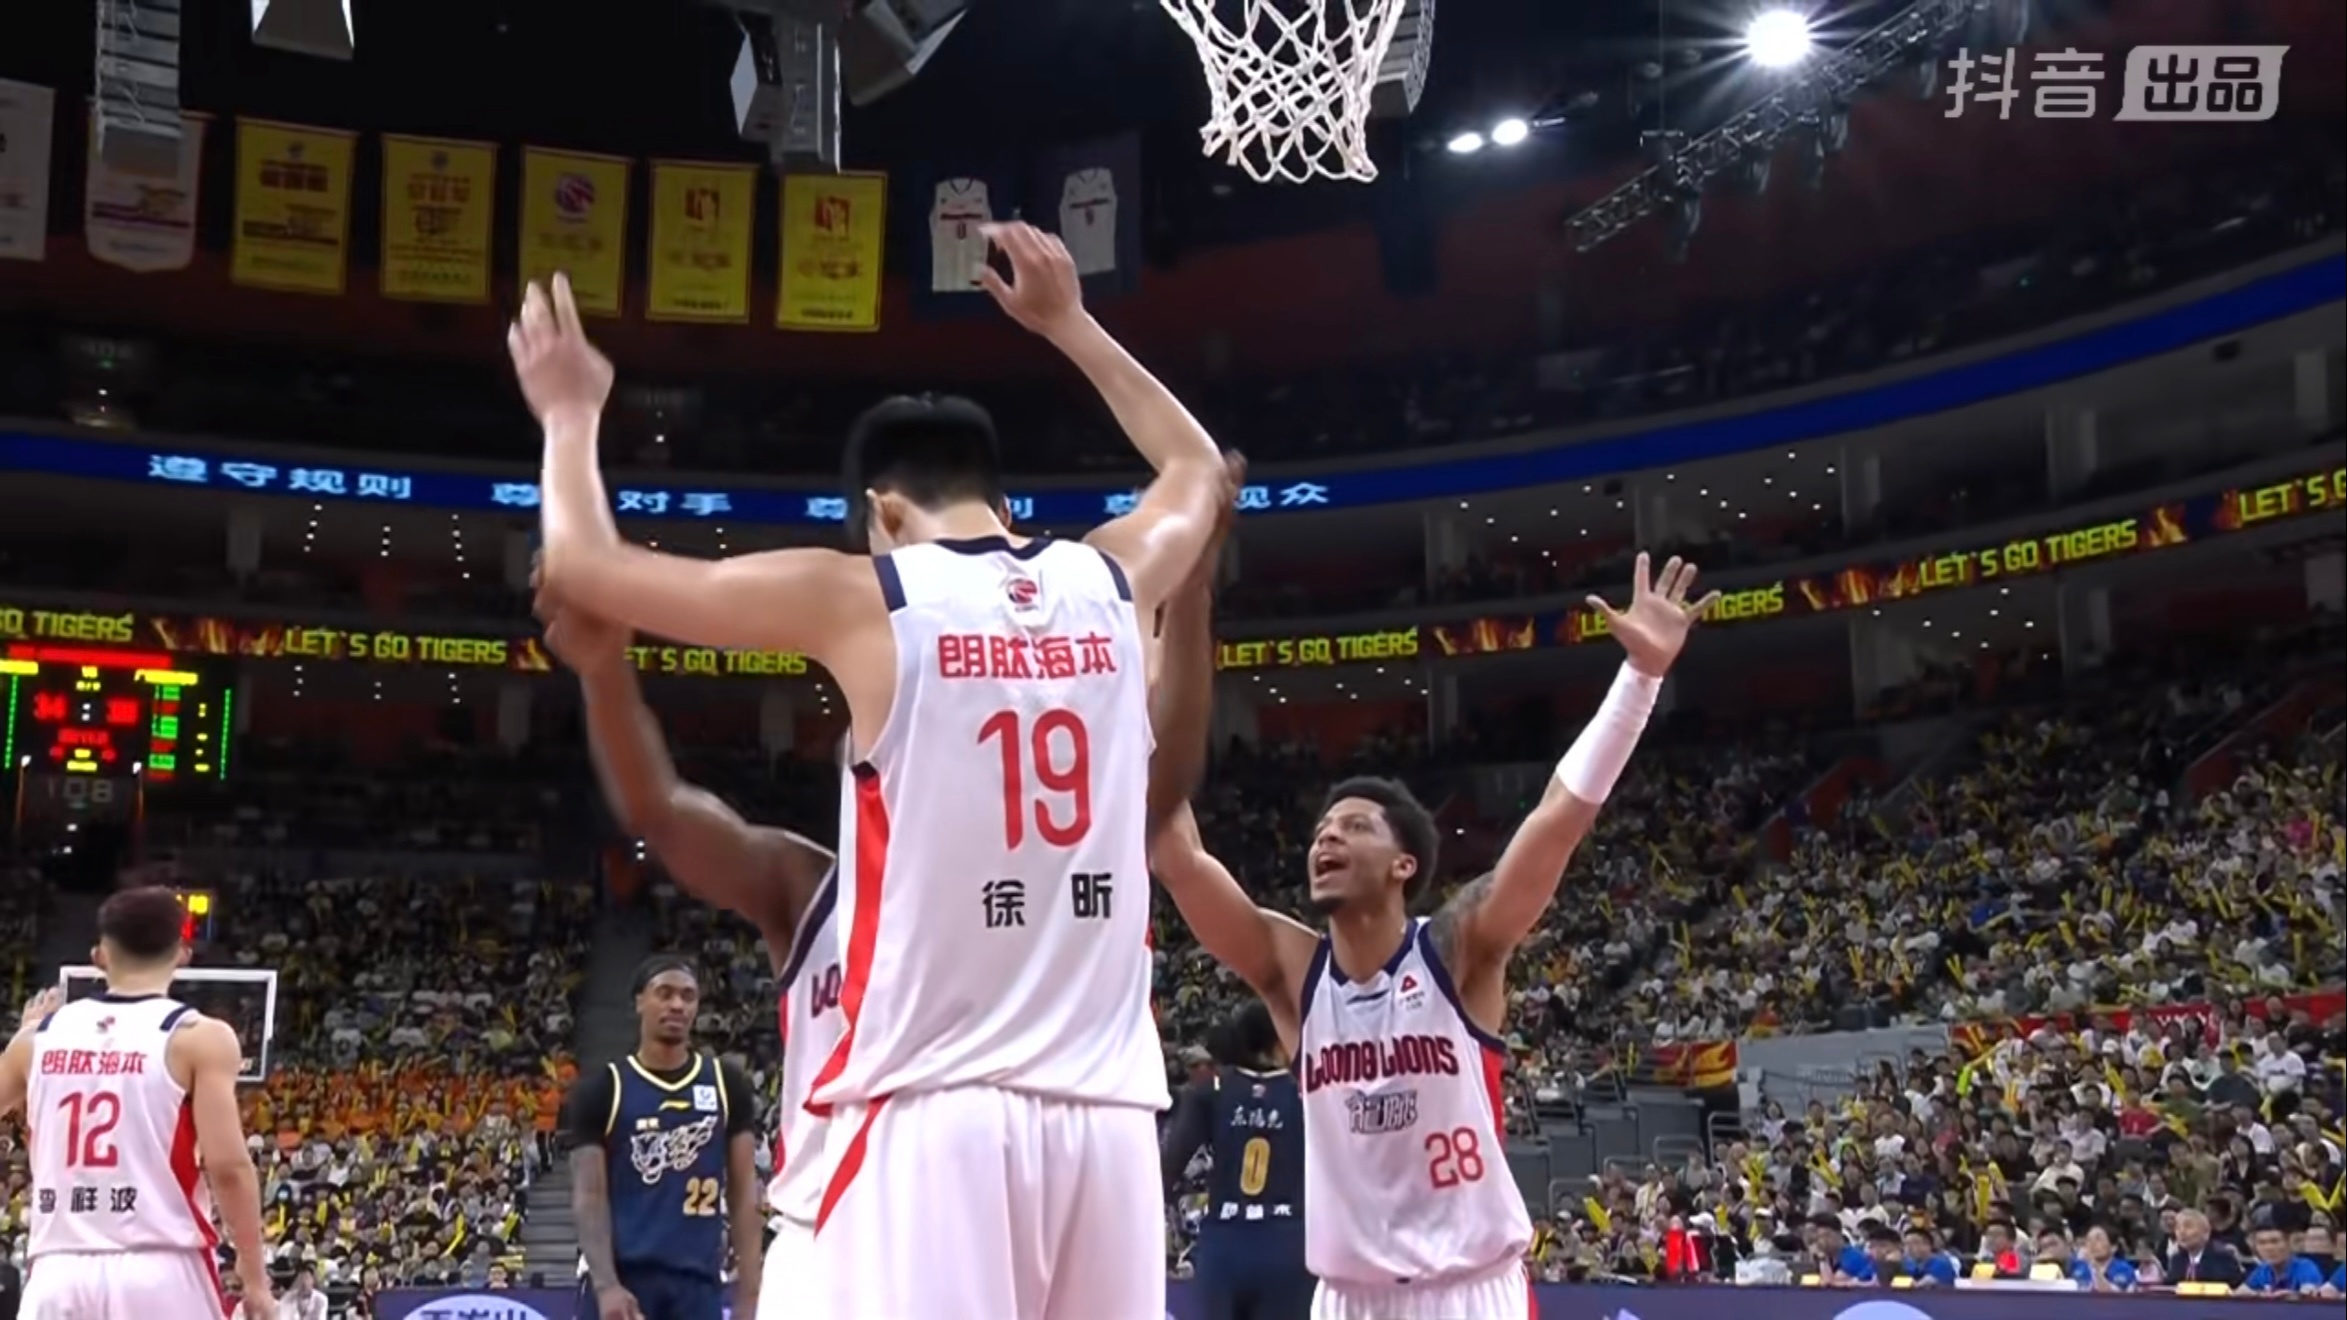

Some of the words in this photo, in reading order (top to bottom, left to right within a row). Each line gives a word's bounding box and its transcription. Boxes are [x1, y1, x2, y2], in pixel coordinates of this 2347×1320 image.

[149, 455, 411, 498] 遵守规则
[2004, 541, 2039, 572] GO
[2045, 518, 2137, 563] TIGERS
[32, 611, 133, 642] TIGERS
[374, 632, 409, 659] GO
[416, 636, 508, 664] TIGERS
[1299, 637, 1331, 663] GO
[1336, 628, 1418, 659] TIGERS
[684, 650, 717, 673] GO
[723, 650, 807, 674] TIGERS
[938, 632, 1117, 680] 朗肽海本
[977, 709, 1092, 850] 19
[58, 1091, 120, 1167] 12
[1240, 1137, 1271, 1196] 0
[1424, 1127, 1484, 1189] 28
[683, 1176, 719, 1216] 22
